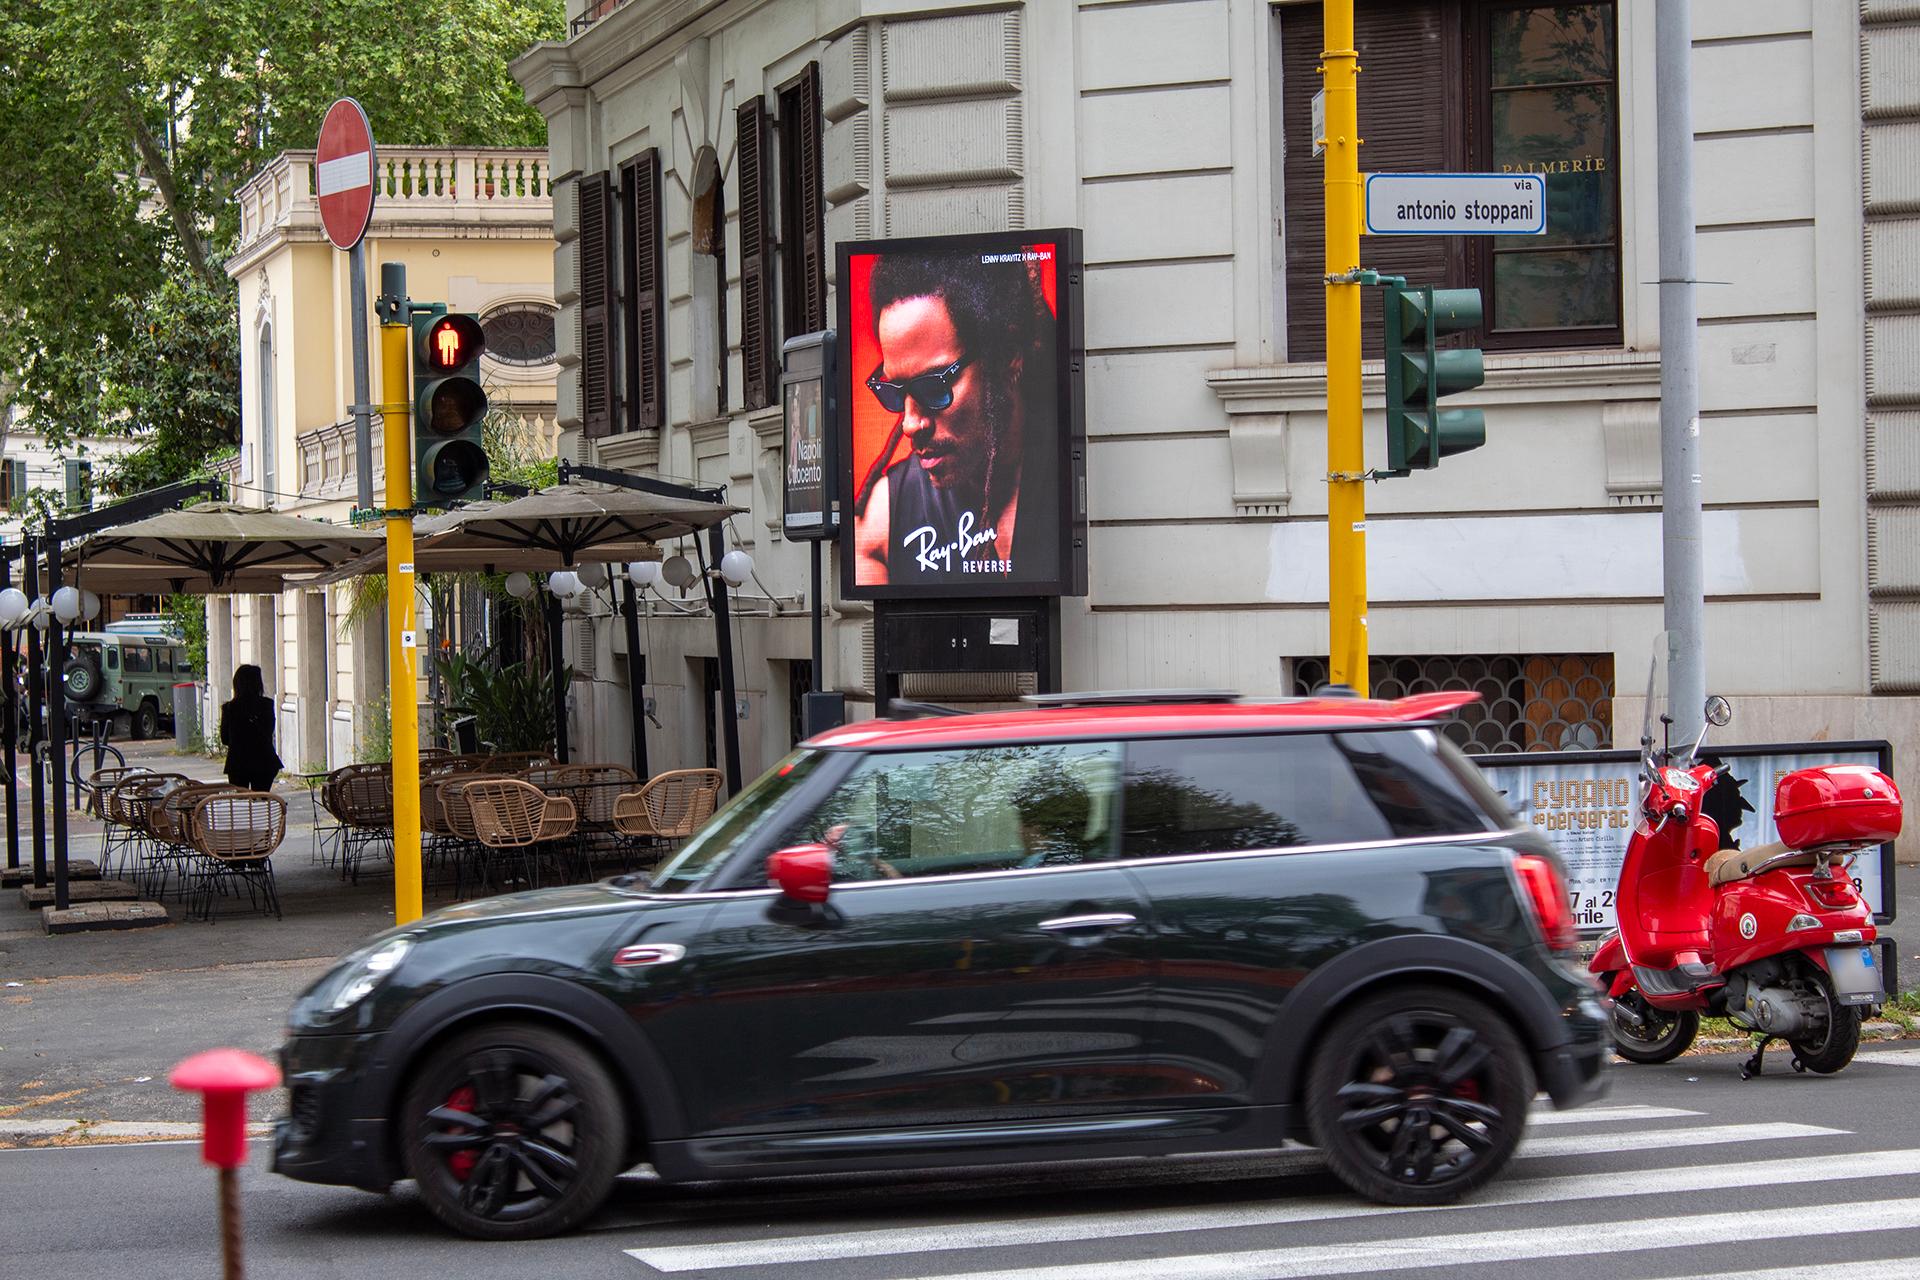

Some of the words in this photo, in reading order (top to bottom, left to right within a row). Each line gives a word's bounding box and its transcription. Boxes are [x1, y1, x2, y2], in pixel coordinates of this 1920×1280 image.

[1514, 180, 1532, 190] via
[1397, 200, 1456, 220] antonio
[1464, 200, 1533, 224] stoppani
[981, 255, 999, 264] LENNY
[1000, 253, 1021, 263] KRAVITZ
[1027, 252, 1051, 261] RAY-BAN
[798, 438, 822, 464] Napoli
[963, 560, 1012, 573] REVERSE
[1533, 779, 1629, 809] CYRANO
[1533, 812, 1545, 825] de
[1547, 809, 1629, 831] bergerac
[1585, 896, 1597, 909] al
[1602, 891, 1617, 907] 2
